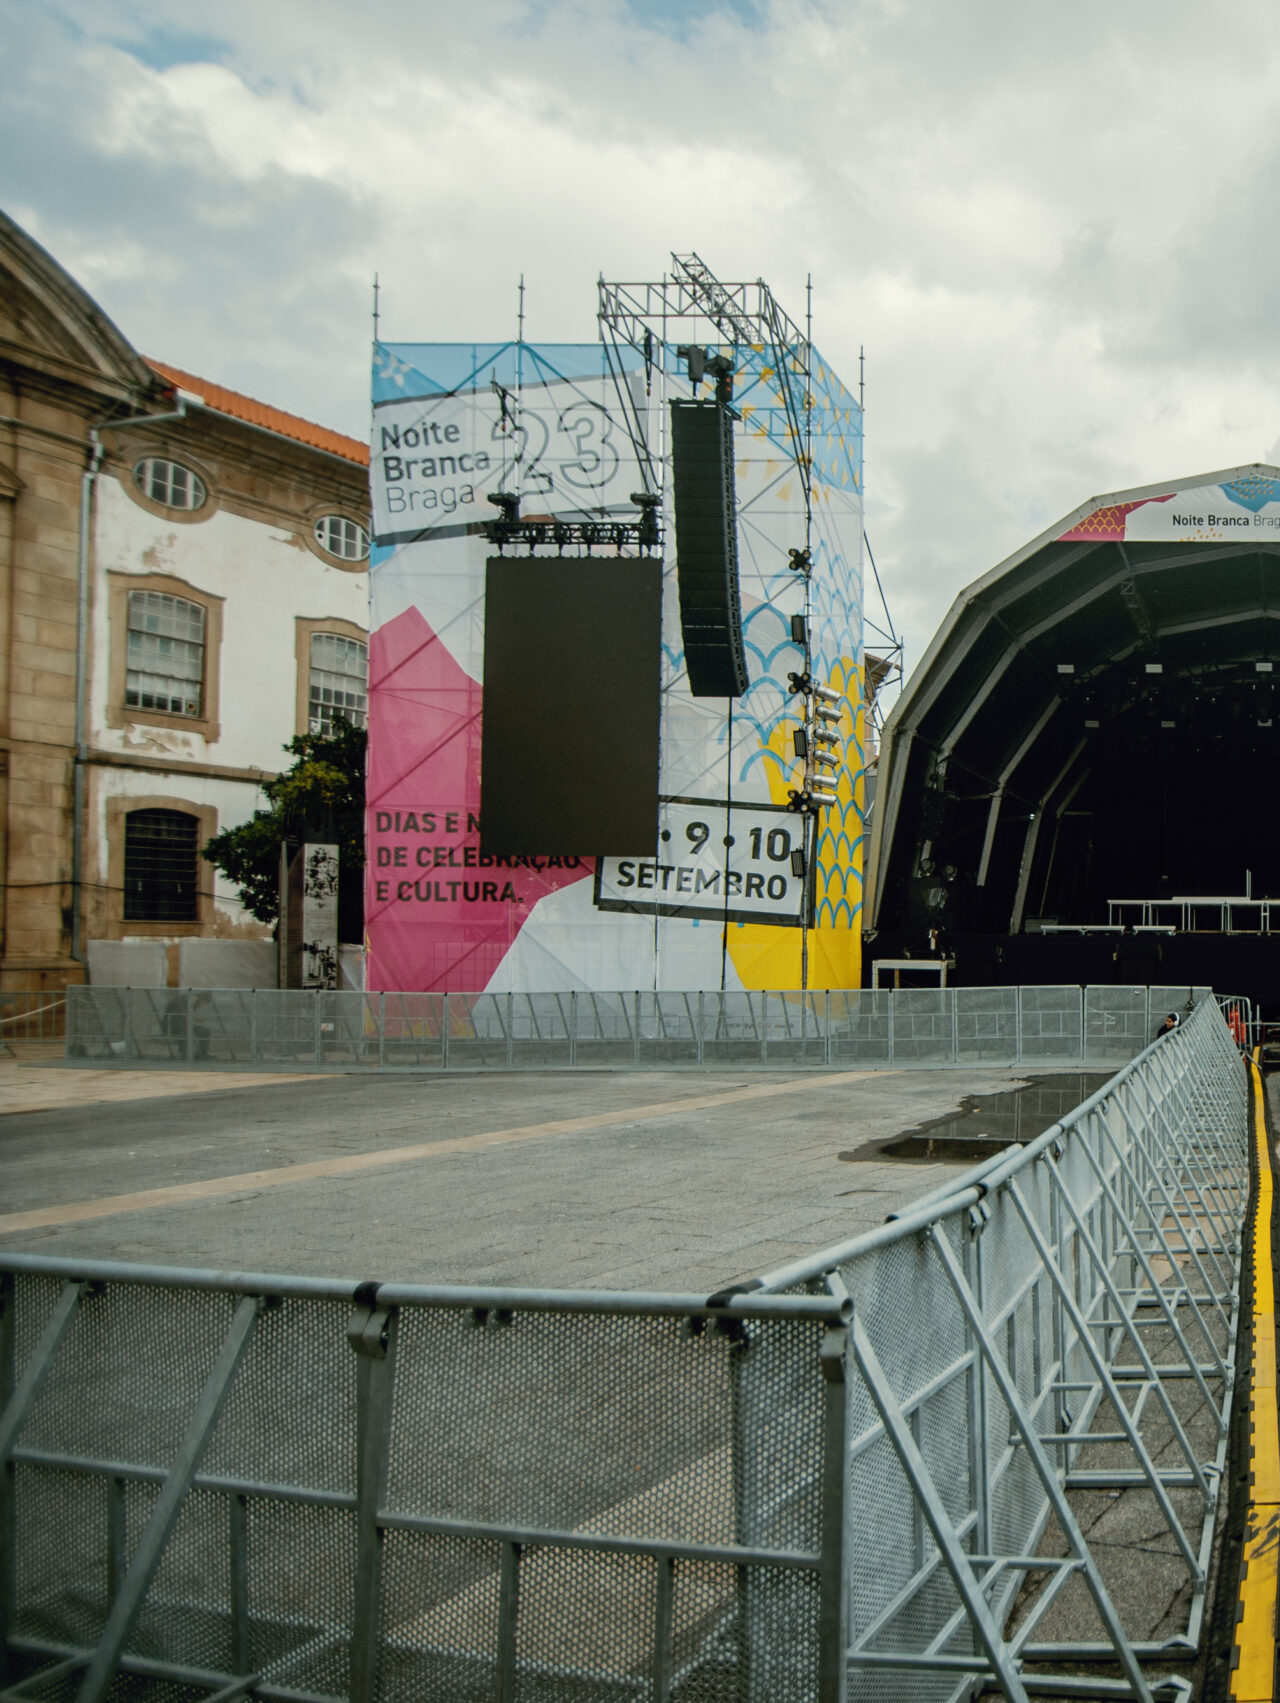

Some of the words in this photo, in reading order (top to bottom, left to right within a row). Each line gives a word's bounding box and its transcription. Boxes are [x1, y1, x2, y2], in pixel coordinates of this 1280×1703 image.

[381, 421, 461, 451] Noite
[492, 400, 620, 496] 23
[383, 450, 491, 482] Branca
[386, 484, 476, 513] Braga
[1172, 514, 1204, 526] Noite
[1207, 514, 1250, 526] Branca
[376, 811, 437, 833] DIAS
[445, 812, 459, 833] E
[686, 821, 710, 854] 9
[749, 827, 792, 862] 10
[377, 847, 408, 867] DE
[376, 881, 389, 901] E
[397, 881, 524, 903] CULTURA.
[617, 860, 788, 900] SETEMBRO
